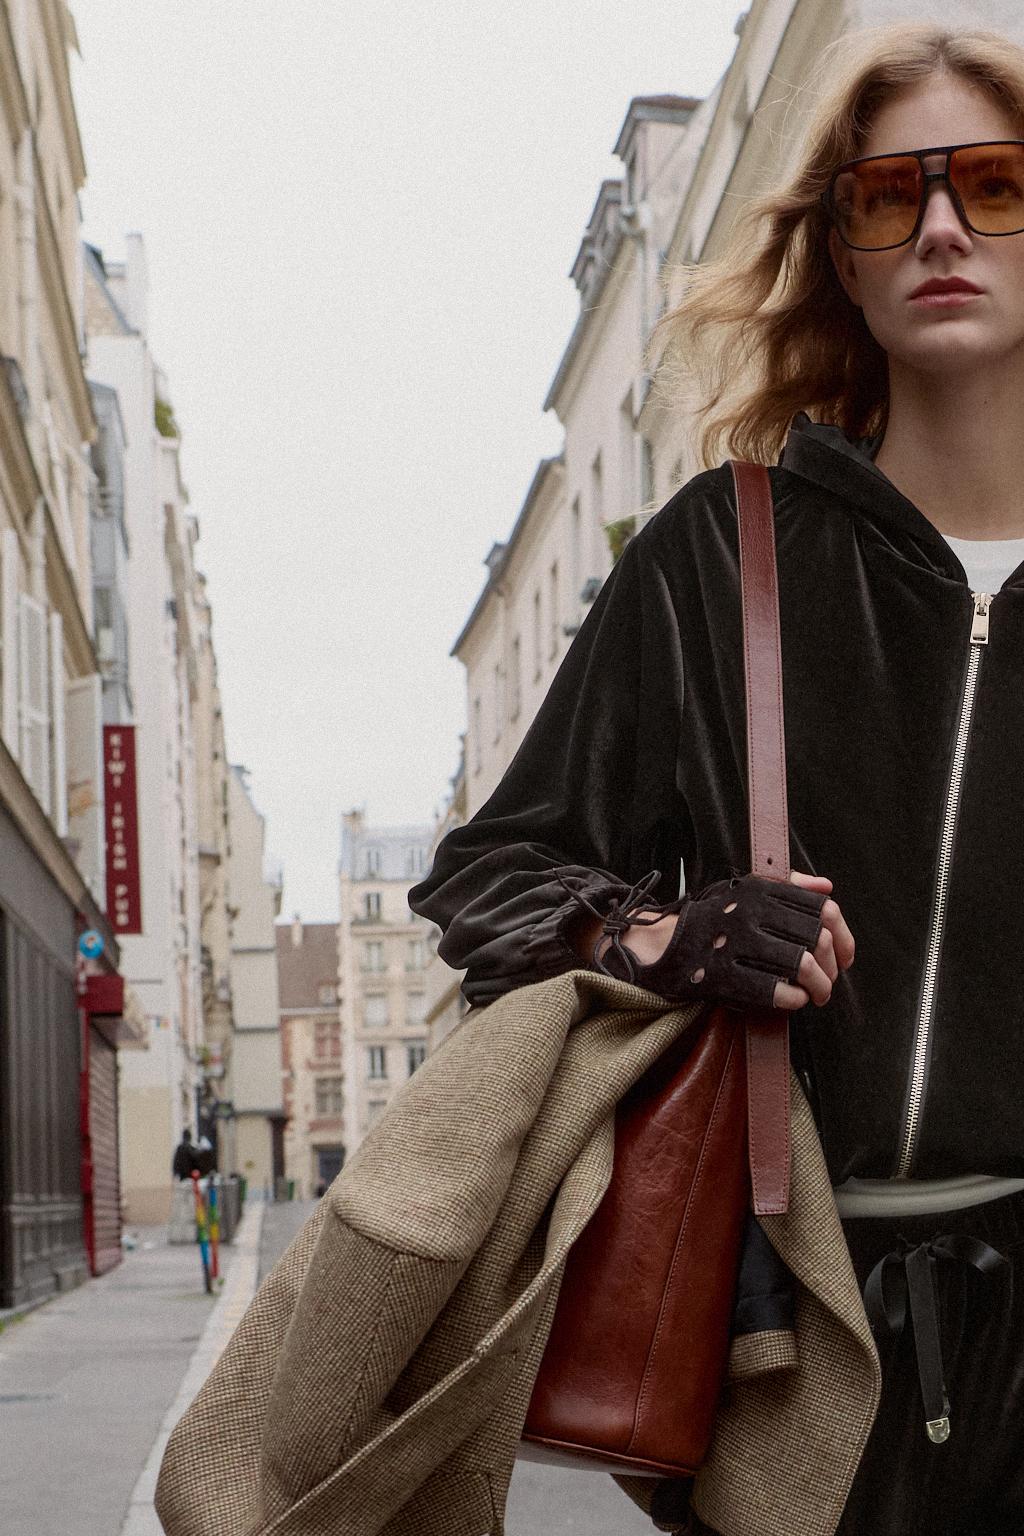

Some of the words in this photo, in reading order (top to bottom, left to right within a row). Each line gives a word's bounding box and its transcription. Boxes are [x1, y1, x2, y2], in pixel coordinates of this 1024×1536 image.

[108, 733, 126, 788] KIWI
[111, 802, 127, 870] IRISH
[115, 883, 129, 926] PUB
